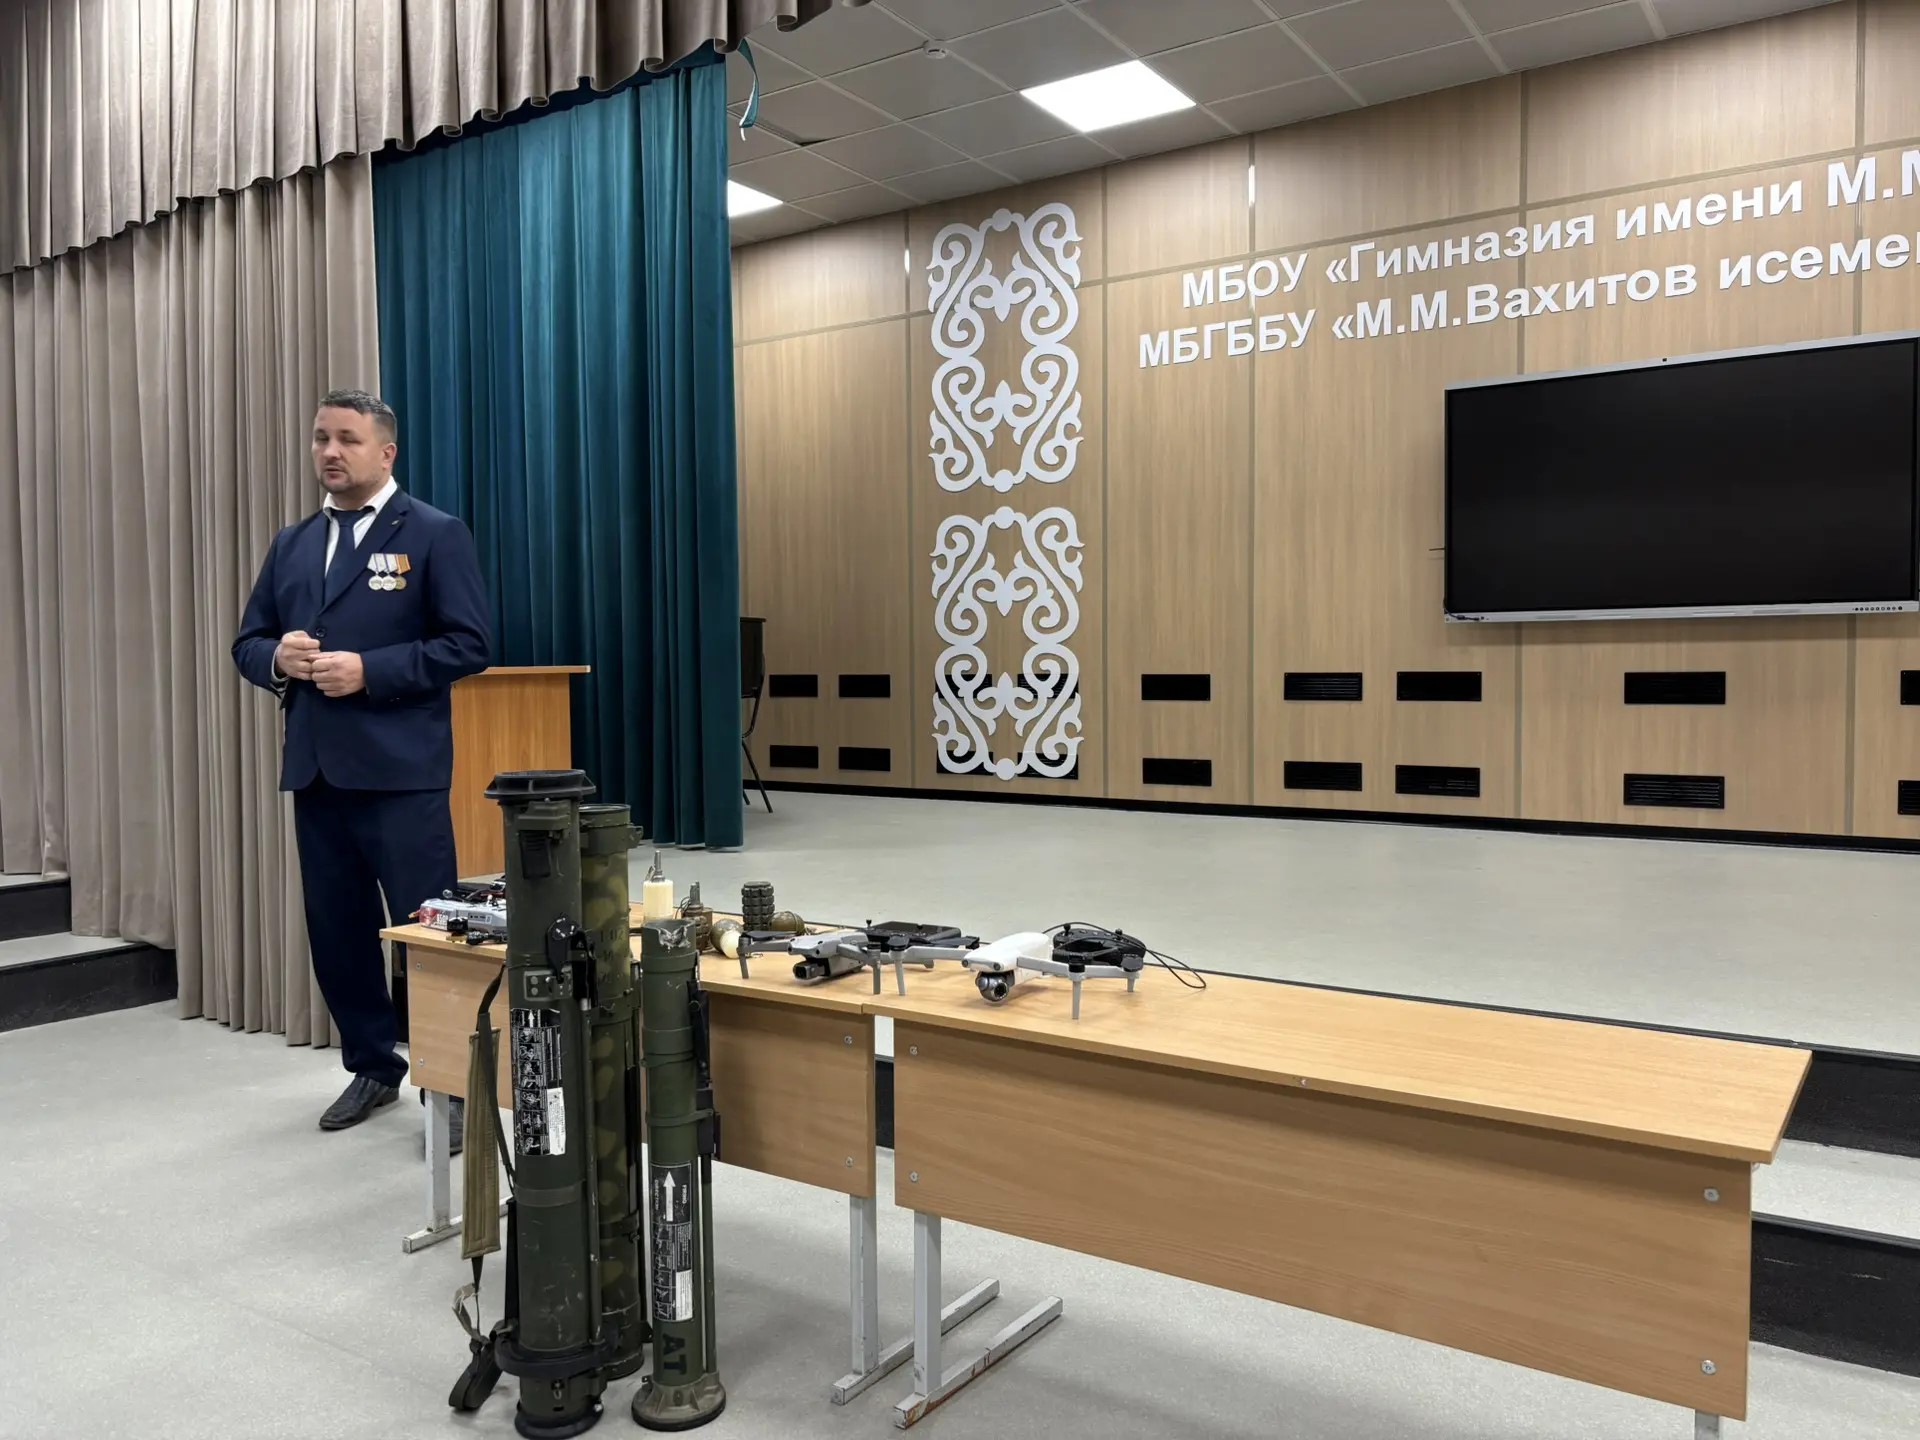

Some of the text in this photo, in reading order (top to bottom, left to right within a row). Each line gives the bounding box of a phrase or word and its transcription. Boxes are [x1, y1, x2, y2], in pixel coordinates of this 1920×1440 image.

[1139, 231, 1920, 369] МБГББУ «М.М.Вахитов исеме
[1182, 253, 1308, 308] МБОУ
[1325, 214, 1595, 284] «Гимназия
[1615, 181, 1803, 241] имени
[663, 1333, 687, 1375] AT
